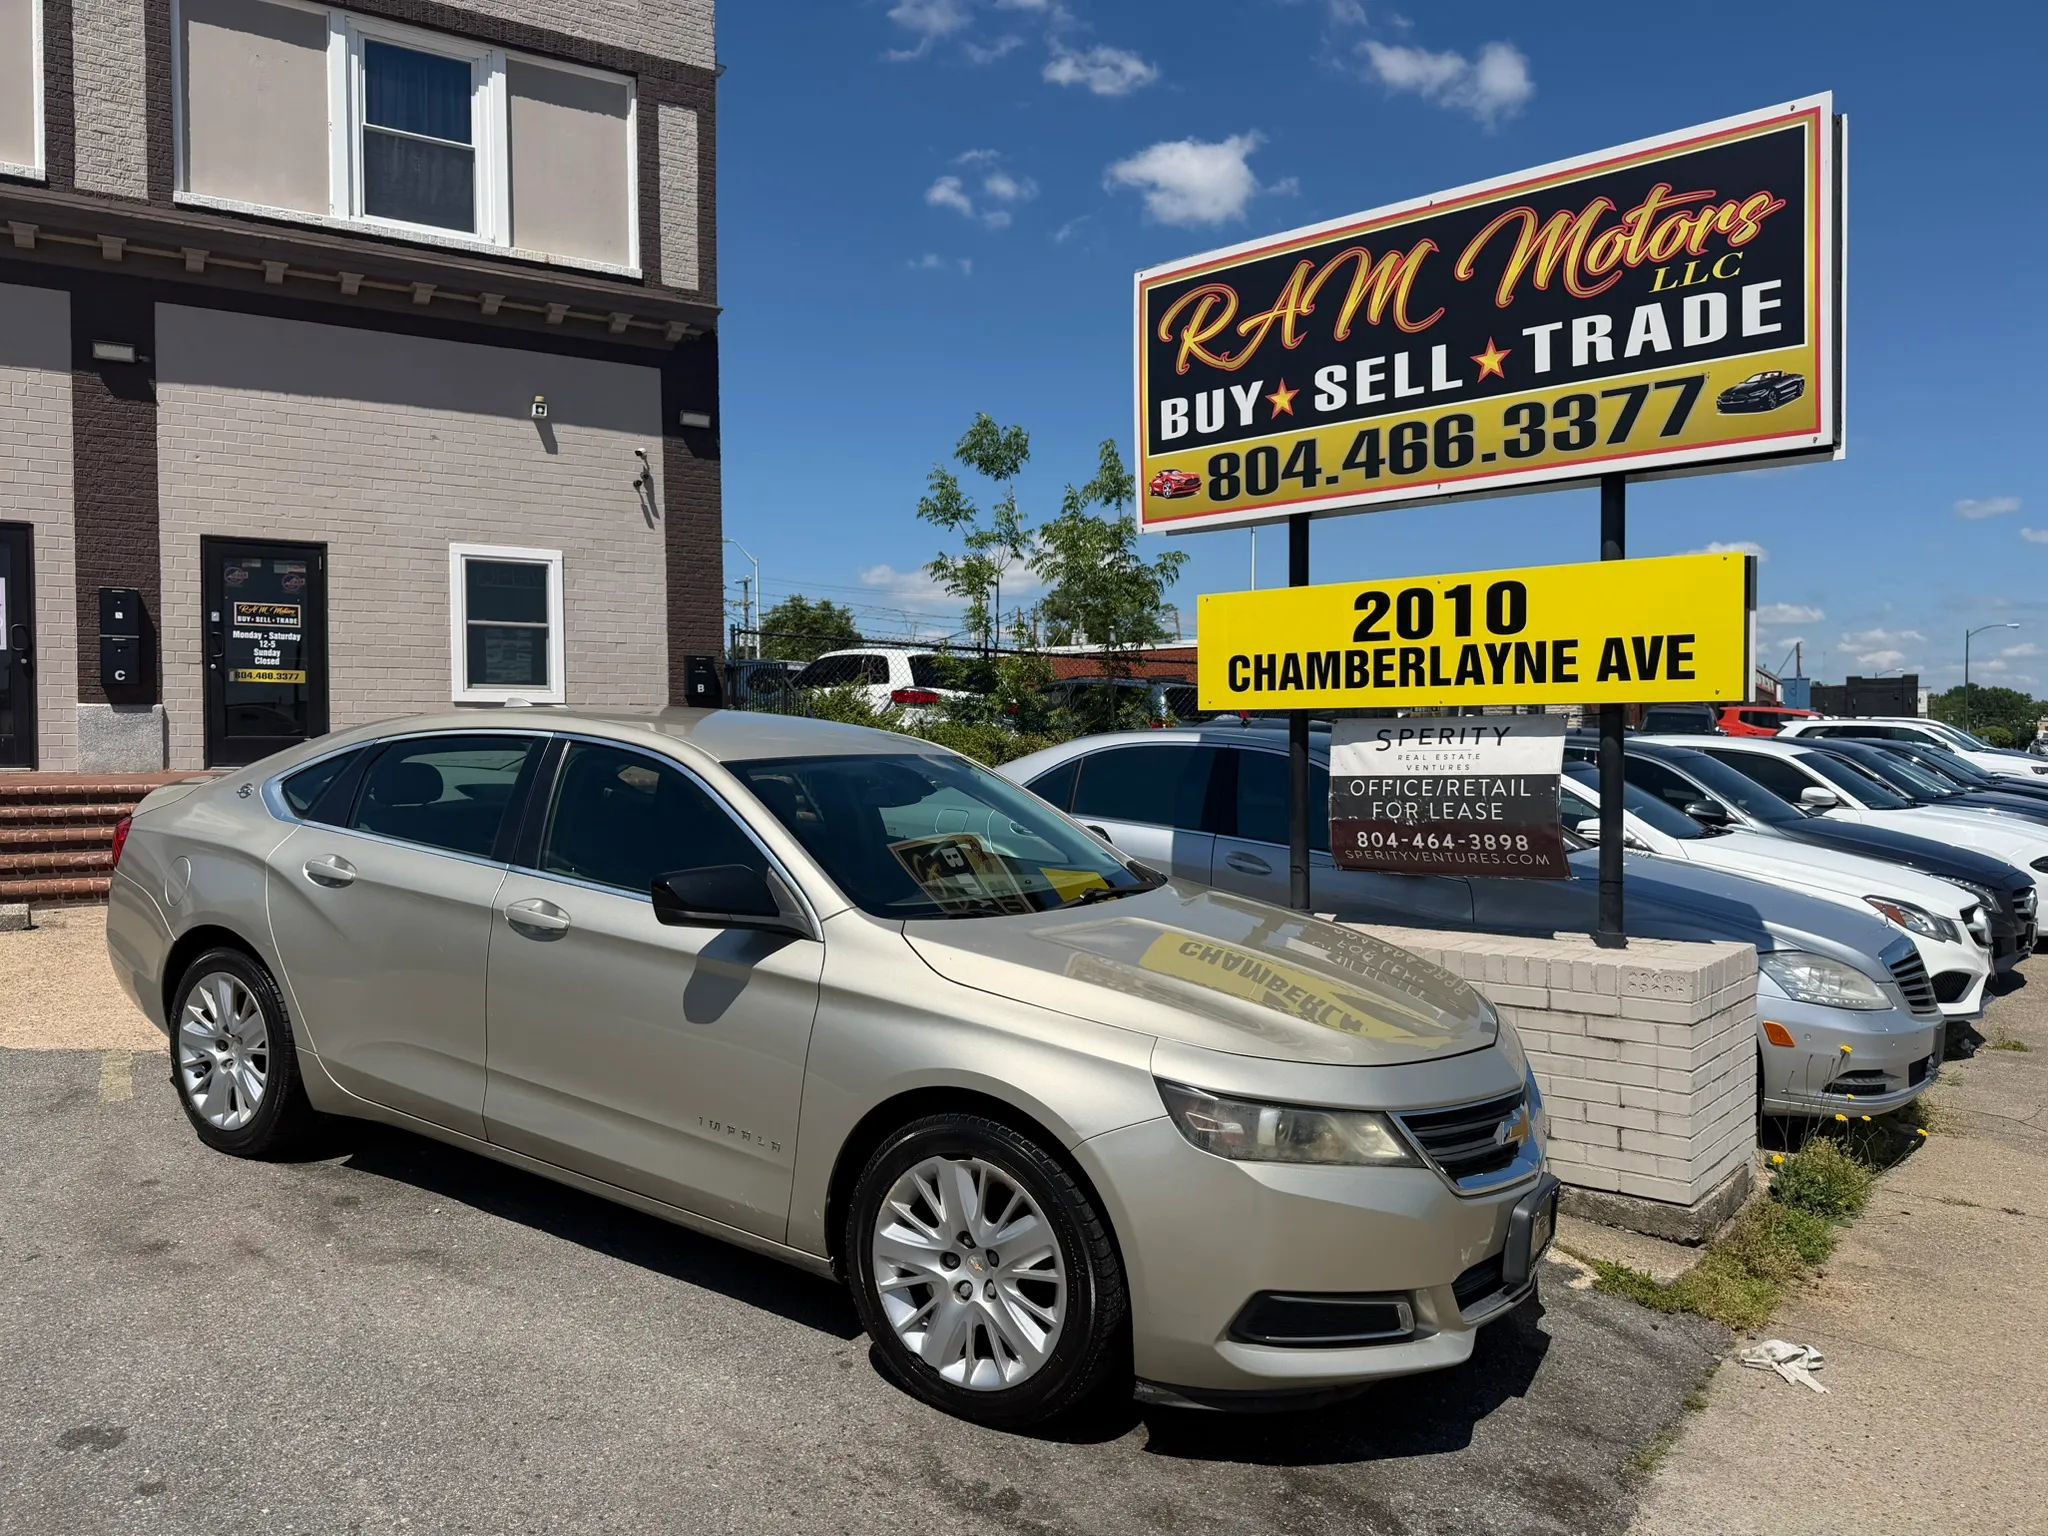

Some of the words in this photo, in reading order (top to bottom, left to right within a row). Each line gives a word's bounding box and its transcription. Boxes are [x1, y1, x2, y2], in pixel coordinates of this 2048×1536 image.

[1157, 238, 1446, 376] RAM
[1454, 182, 1788, 309] Motors
[1649, 251, 1743, 293] LLC
[1160, 379, 1264, 441] BUY
[1314, 343, 1464, 412] SELL
[1522, 279, 1783, 374] TRADE
[1208, 374, 1706, 502] 804.466.3377
[238, 615, 251, 623] BUY
[276, 617, 298, 625] TRADE
[1352, 580, 1528, 642] 2010
[233, 631, 262, 640] Monday
[268, 632, 301, 642] Saturday
[259, 640, 276, 648] 12-5
[253, 648, 280, 658] Sunday
[255, 657, 280, 665] Closed
[1228, 639, 1579, 693] CHAMBERLAYNE
[1597, 633, 1697, 682] AVE
[1376, 726, 1513, 752] SPERITY
[1397, 754, 1427, 762] REAL
[1436, 753, 1481, 761] ESTATE
[1406, 764, 1471, 772] VENTURES
[1350, 778, 1531, 797] OFFICE/RETAIL
[1373, 801, 1419, 819] FOR
[1429, 802, 1504, 821] LEASE
[1357, 831, 1530, 852] 804-464-3898
[1345, 849, 1551, 866] SPERITYVENTURES.COM
[698, 1116, 781, 1152] IMPALA
